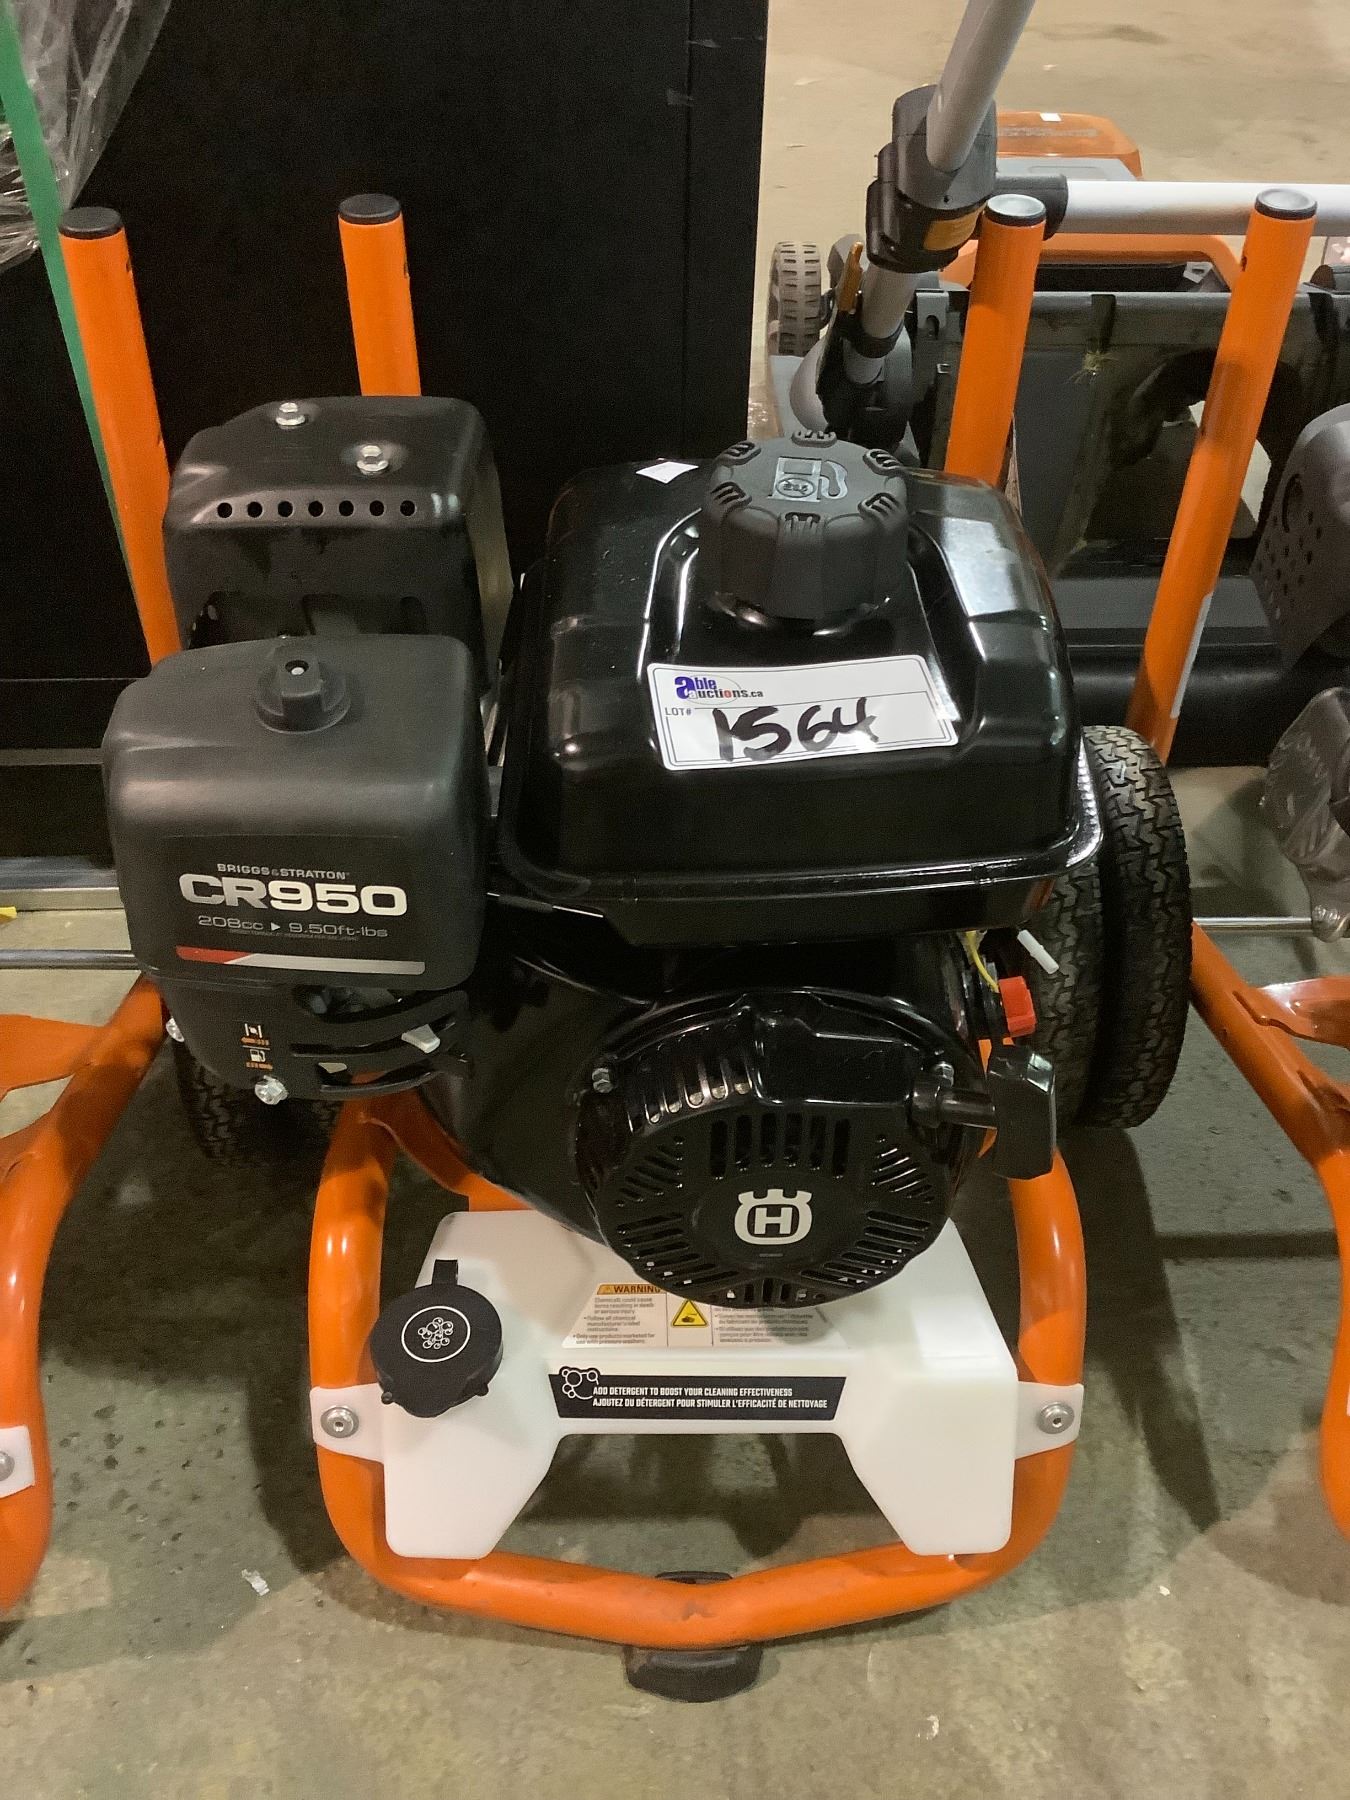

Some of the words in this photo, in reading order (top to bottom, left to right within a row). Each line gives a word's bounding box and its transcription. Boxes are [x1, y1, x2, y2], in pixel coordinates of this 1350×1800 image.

[674, 676, 717, 700] able
[688, 688, 764, 699] auctions.ca
[665, 707, 691, 716] LOT#
[712, 697, 879, 762] 1564
[179, 873, 407, 917] CR950
[198, 915, 264, 930] 208cc
[288, 922, 388, 938] 9.50ft-lbs
[592, 1386, 608, 1396] ADD
[609, 1387, 648, 1396] DETERGENT
[650, 1387, 659, 1396] TO
[660, 1387, 682, 1396] BOOST
[684, 1387, 703, 1397] YOUR
[704, 1388, 738, 1397] CLEANING
[739, 1388, 793, 1397] EFFECTIVENESS
[592, 1398, 624, 1407] AJOUTEZ
[625, 1398, 634, 1407] DU
[636, 1397, 675, 1407] DÉTERGENT
[676, 1399, 695, 1408] POUR
[697, 1399, 731, 1408] STIMULER
[732, 1398, 776, 1408] L'EFFICACITÉ
[778, 1399, 788, 1408] DE
[789, 1399, 828, 1408] NETTOYAGE
